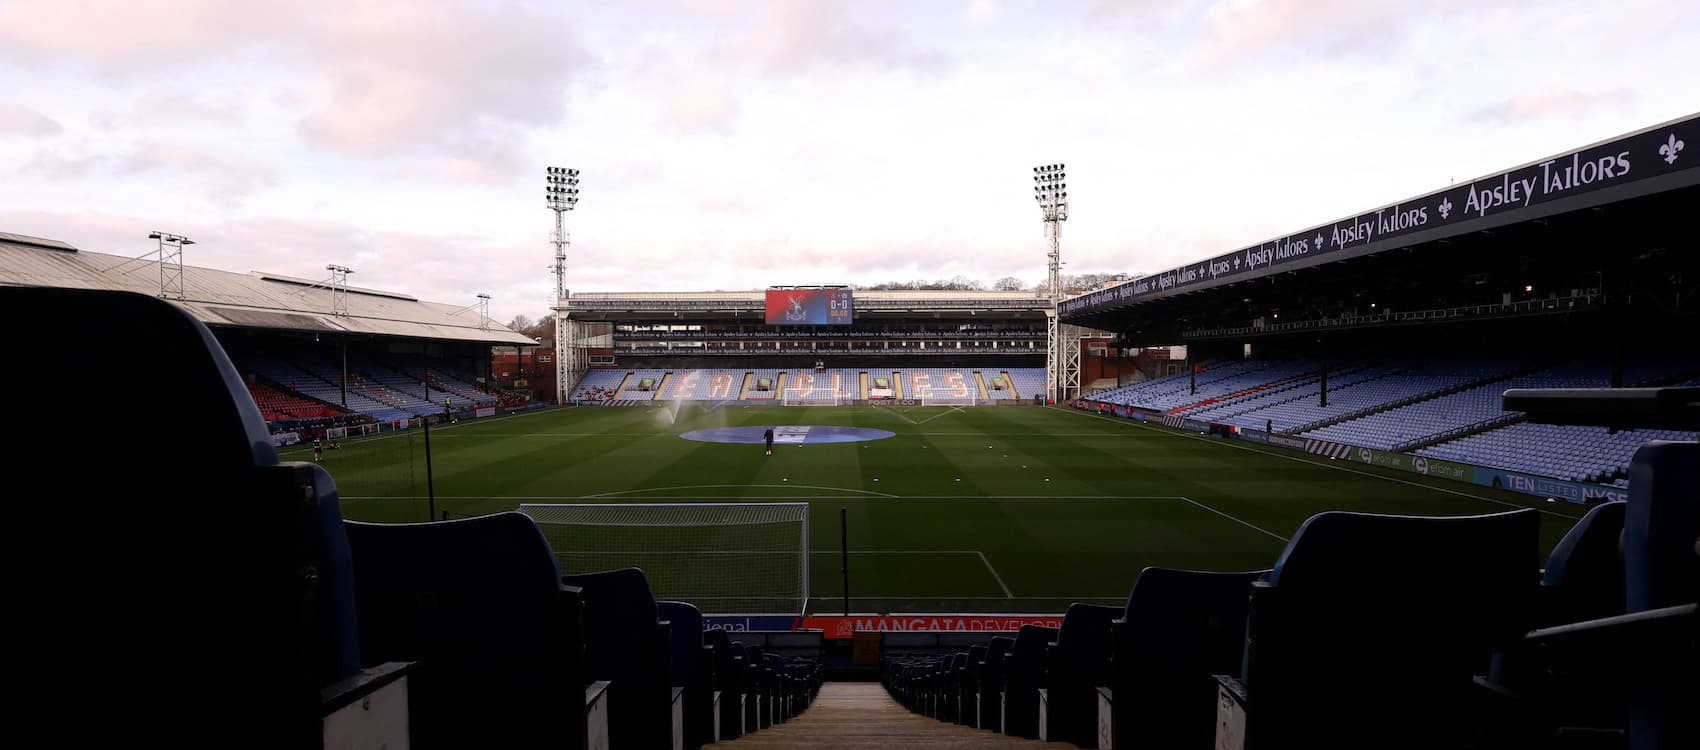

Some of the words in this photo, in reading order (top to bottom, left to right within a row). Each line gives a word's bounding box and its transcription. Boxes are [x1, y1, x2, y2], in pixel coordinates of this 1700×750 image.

[1464, 174, 1537, 216] Apsley
[1331, 217, 1375, 250] Apsley
[1244, 244, 1275, 270] Apsley
[831, 300, 847, 309] 0-0
[1505, 475, 1534, 491] TEN
[1538, 480, 1577, 497] LISTED
[703, 618, 750, 631] ional
[856, 619, 967, 631] MANGATA
